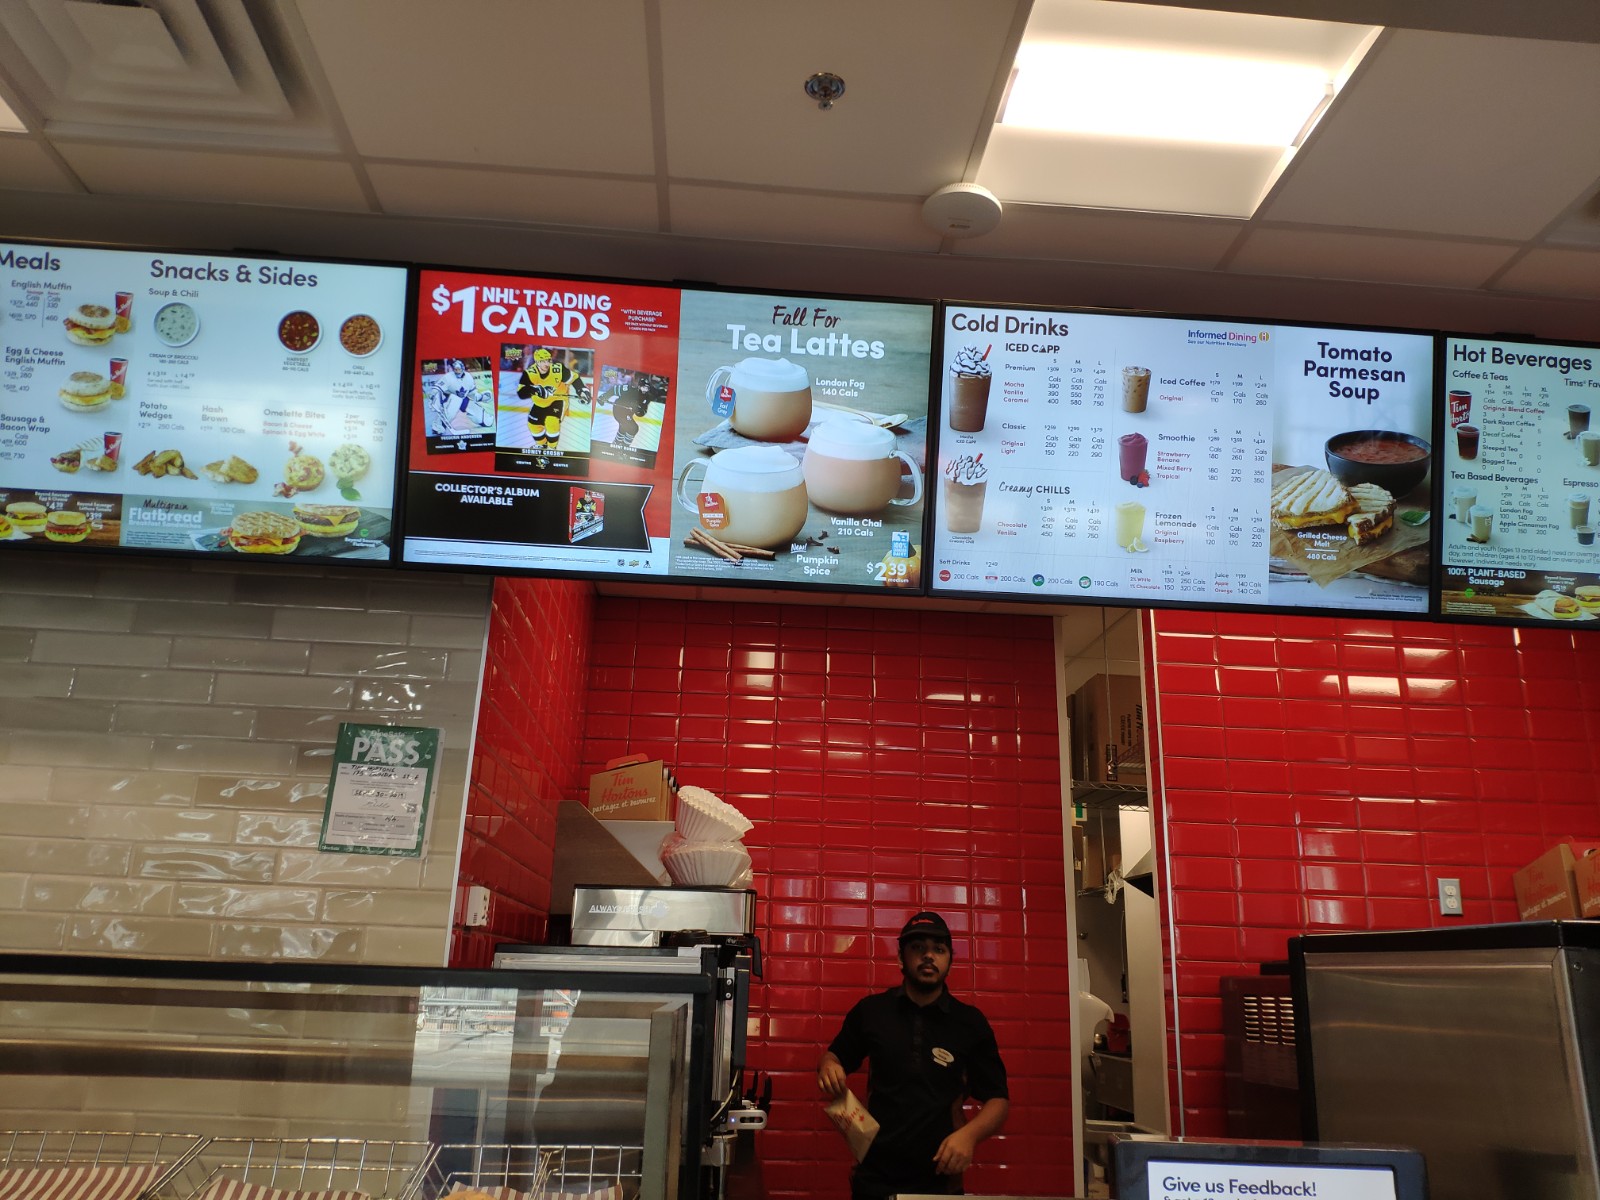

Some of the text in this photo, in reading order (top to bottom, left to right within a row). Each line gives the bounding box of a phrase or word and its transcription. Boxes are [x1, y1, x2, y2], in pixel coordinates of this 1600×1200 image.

[0, 250, 61, 272] Meals
[151, 260, 318, 288] Snacks & Sides
[12, 280, 72, 290] English Muffin
[149, 288, 169, 298] Soup
[180, 289, 199, 297] Chili
[523, 290, 613, 312] TRADING
[772, 305, 842, 329] Fall For
[481, 305, 610, 341] CARDS
[952, 313, 1069, 337] Cold Drinks
[727, 324, 886, 360] Tea Lattes
[1187, 330, 1257, 344] Informed Dining
[6, 346, 63, 358] Egg Cheese
[1005, 342, 1029, 351] ICED
[1317, 341, 1393, 363] Tomato
[5, 356, 65, 367] English Muffin
[1453, 344, 1593, 375] Hot Beverages
[1005, 364, 1036, 372] Premium
[1304, 360, 1406, 383] Parmesan
[1452, 370, 1481, 378] Coffee
[815, 377, 866, 388] London Fog
[1179, 379, 1206, 387] Coffee
[822, 388, 859, 398] 140 Cals
[1328, 381, 1380, 405] Soup
[1160, 395, 1184, 403] Original
[140, 401, 168, 410] Potato
[202, 404, 223, 413] Hash
[139, 410, 173, 421] Wedges
[201, 414, 228, 423] Brown
[263, 408, 325, 418] Omelette Bites
[0, 414, 37, 426] Sausage
[0, 423, 50, 435] Bacon Wrap
[1002, 422, 1028, 430] Classic
[1158, 433, 1195, 442] Smoothie
[1001, 440, 1027, 448] Original
[1483, 445, 1507, 453] Steeped
[1157, 450, 1191, 458] Strawberry
[1482, 458, 1505, 466] Bagged
[1176, 466, 1193, 474] Berry
[1157, 473, 1181, 481] Tropical
[1468, 473, 1494, 481] Based
[1495, 474, 1539, 485] Beverages
[435, 483, 540, 497] COLLECTOR'S ALBUM
[999, 482, 1071, 498] Creamy CHILLS
[1563, 478, 1599, 491] Espresso
[143, 499, 190, 513] Multigrain
[460, 495, 514, 506] AVAILABLE
[129, 508, 203, 524] Flatbread
[1155, 512, 1182, 520] Frozen
[831, 517, 883, 528] Vanilla Chai
[1155, 520, 1197, 528] Lemonade
[838, 528, 874, 537] 210 Cals
[1154, 529, 1179, 537] Original
[1297, 531, 1348, 541] Grilled Cheese
[1154, 537, 1185, 545] Raspberry
[1480, 545, 1497, 553] youth
[796, 554, 839, 567] Pumpkin
[803, 566, 831, 576] Spice
[1447, 567, 1527, 578] 100% PLANT-BASED
[1469, 576, 1505, 587] Sausage
[351, 737, 421, 765] PASS
[612, 772, 634, 786] Tim
[601, 788, 649, 804] Hortons
[592, 796, 657, 815] partagez et savourez
[1162, 1176, 1201, 1192] Give
[1205, 1180, 1225, 1194] us
[1229, 1178, 1317, 1198] Feedback!
